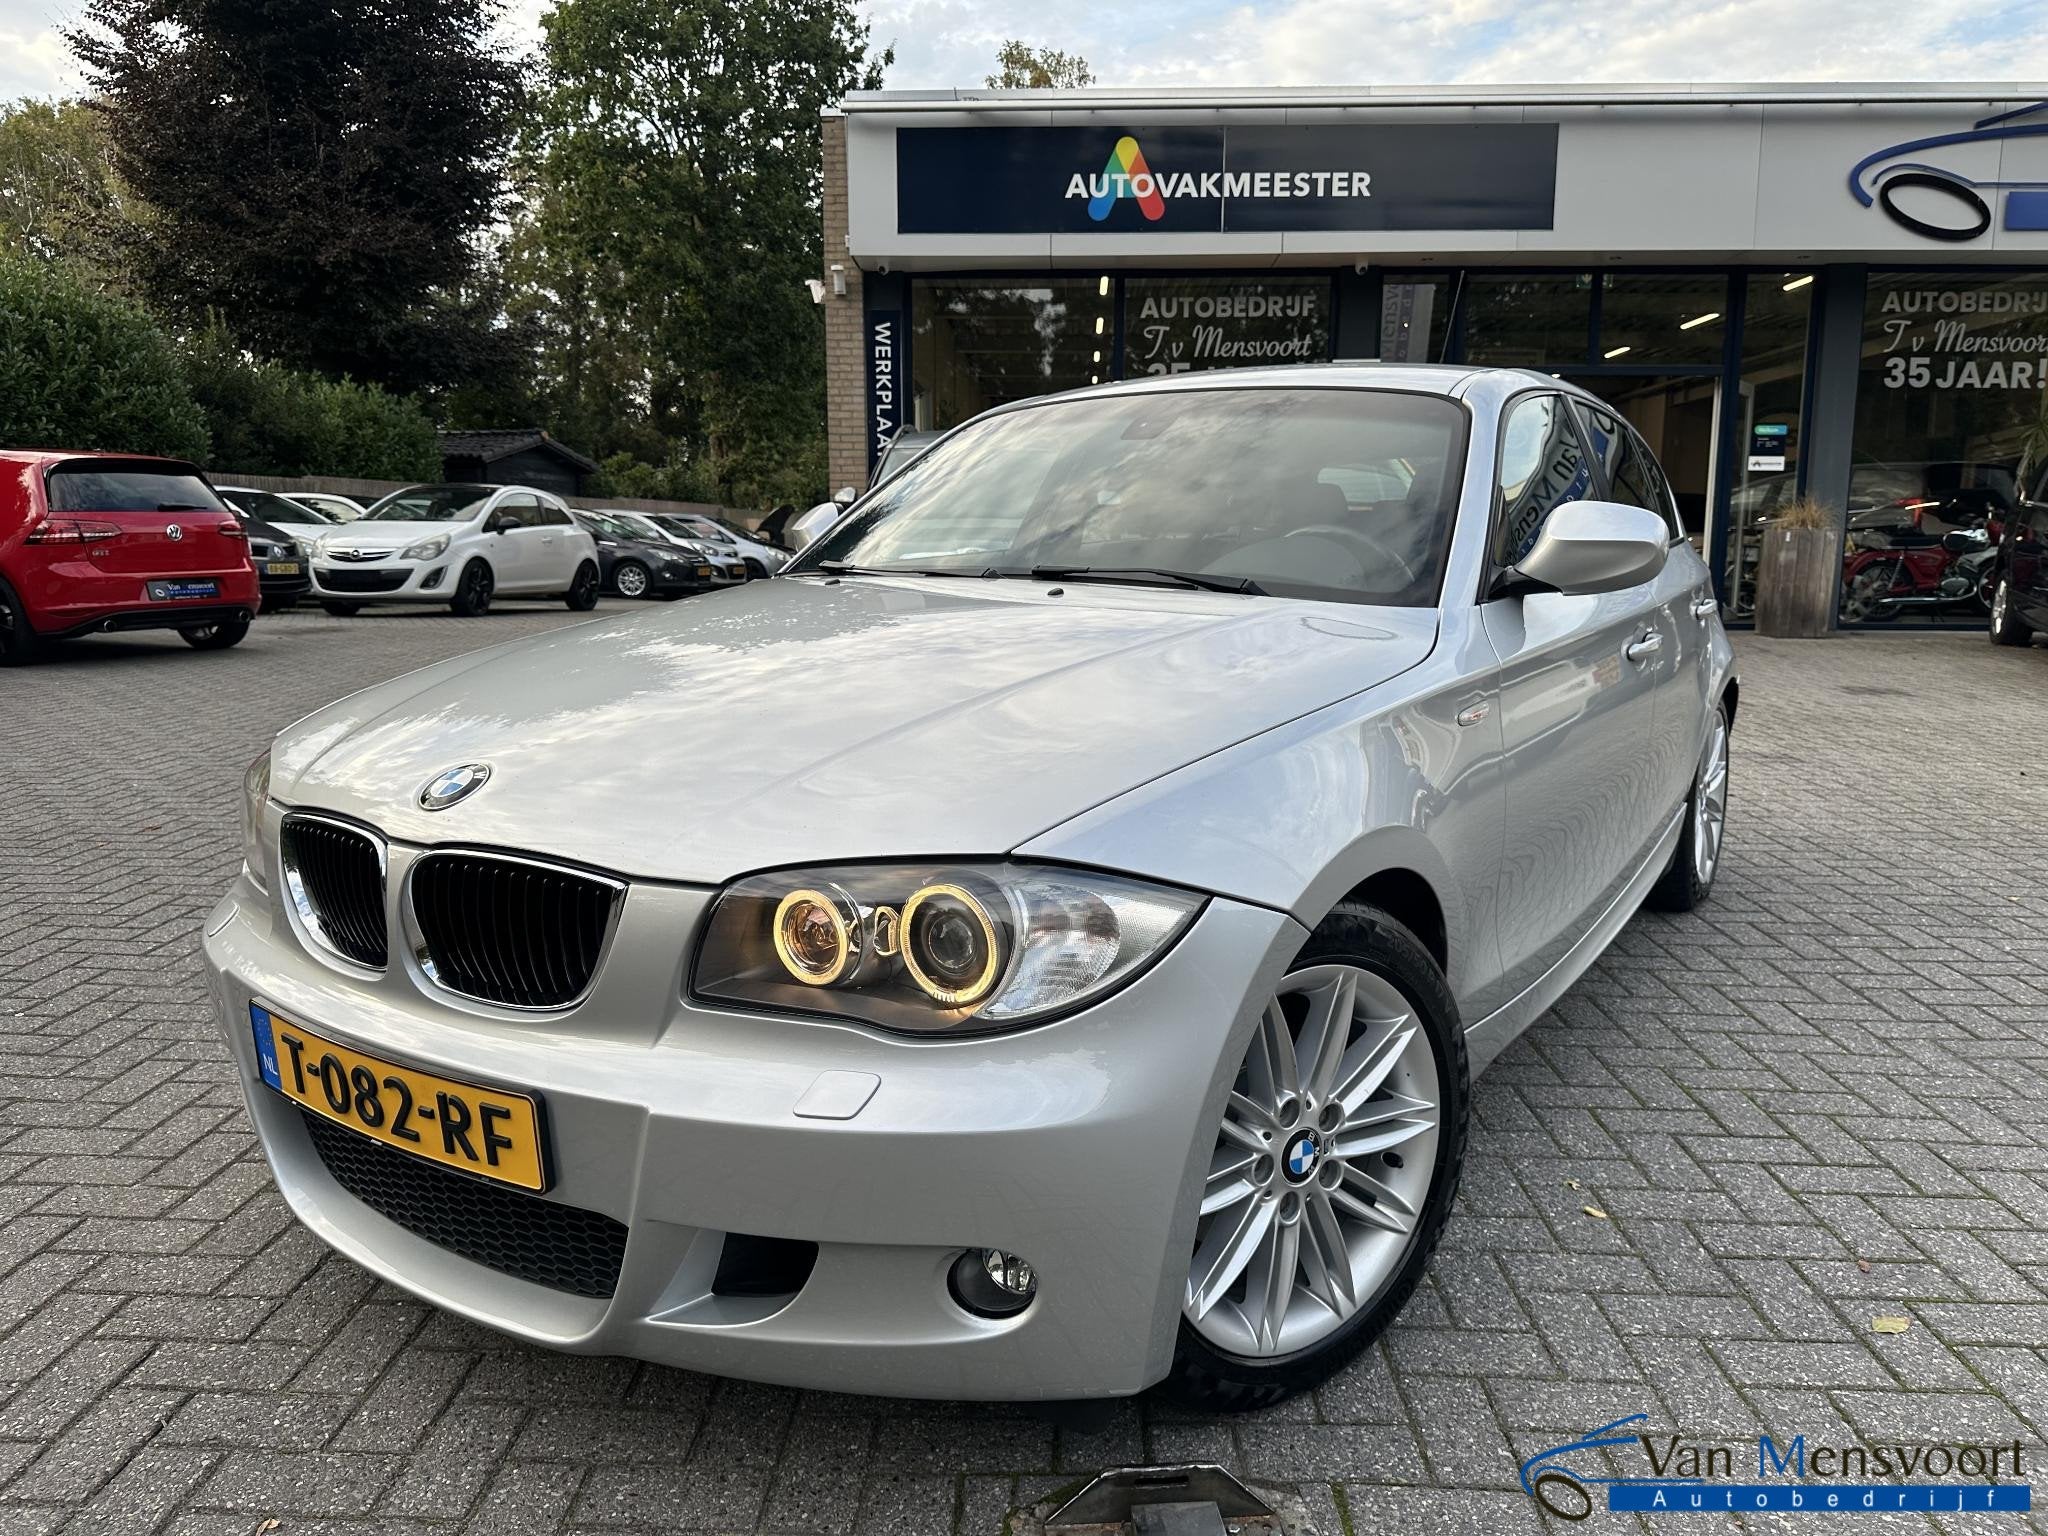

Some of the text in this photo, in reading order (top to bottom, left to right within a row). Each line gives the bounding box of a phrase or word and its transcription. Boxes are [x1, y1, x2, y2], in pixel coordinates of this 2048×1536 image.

[1065, 172, 1371, 199] AUTOVAKMEESTER
[1140, 296, 1317, 319] AUTOBEDRIJF
[1192, 324, 1312, 358] Mensvoort
[1934, 319, 2048, 353] Mensvoor
[1883, 357, 2048, 389] 35 JAAR!
[262, 1053, 278, 1076] NL
[281, 1032, 512, 1166] T-082-RF
